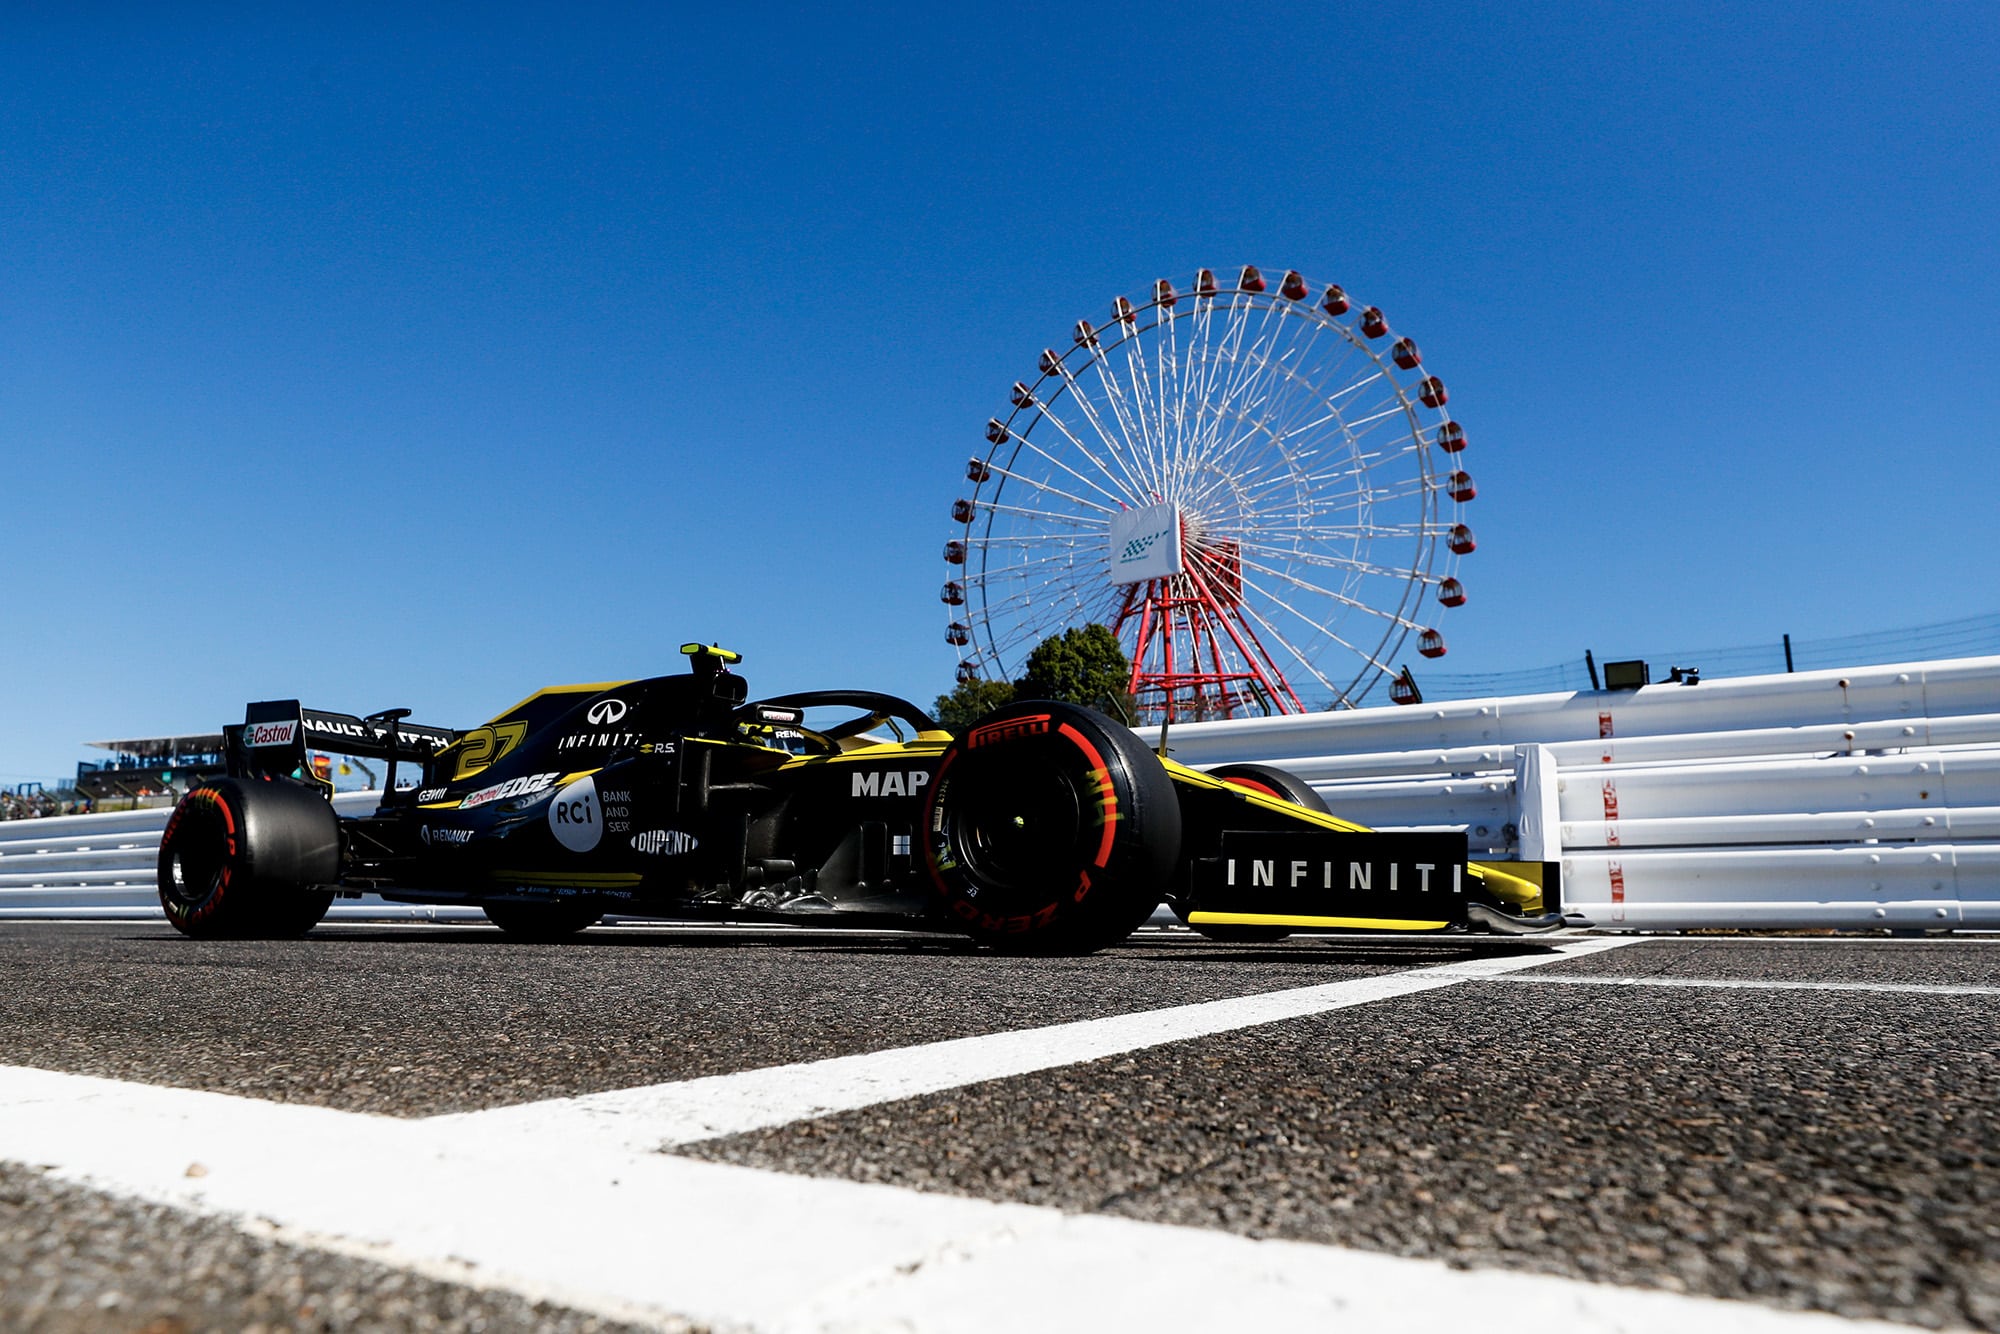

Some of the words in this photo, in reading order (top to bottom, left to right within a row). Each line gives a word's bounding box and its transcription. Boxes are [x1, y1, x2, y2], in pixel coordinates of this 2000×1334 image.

[254, 723, 293, 744] Castrol
[967, 712, 1054, 750] PIRELLI
[452, 720, 528, 781] 27
[497, 772, 561, 798] EDGE
[602, 790, 632, 803] BANK
[852, 771, 930, 797] MAP
[605, 806, 630, 818] AND
[432, 829, 475, 843] RENAULT
[608, 821, 631, 833] SER
[637, 829, 692, 855] DUPONT
[1226, 857, 1463, 894] INFINITI
[952, 898, 1061, 934] ZERO
